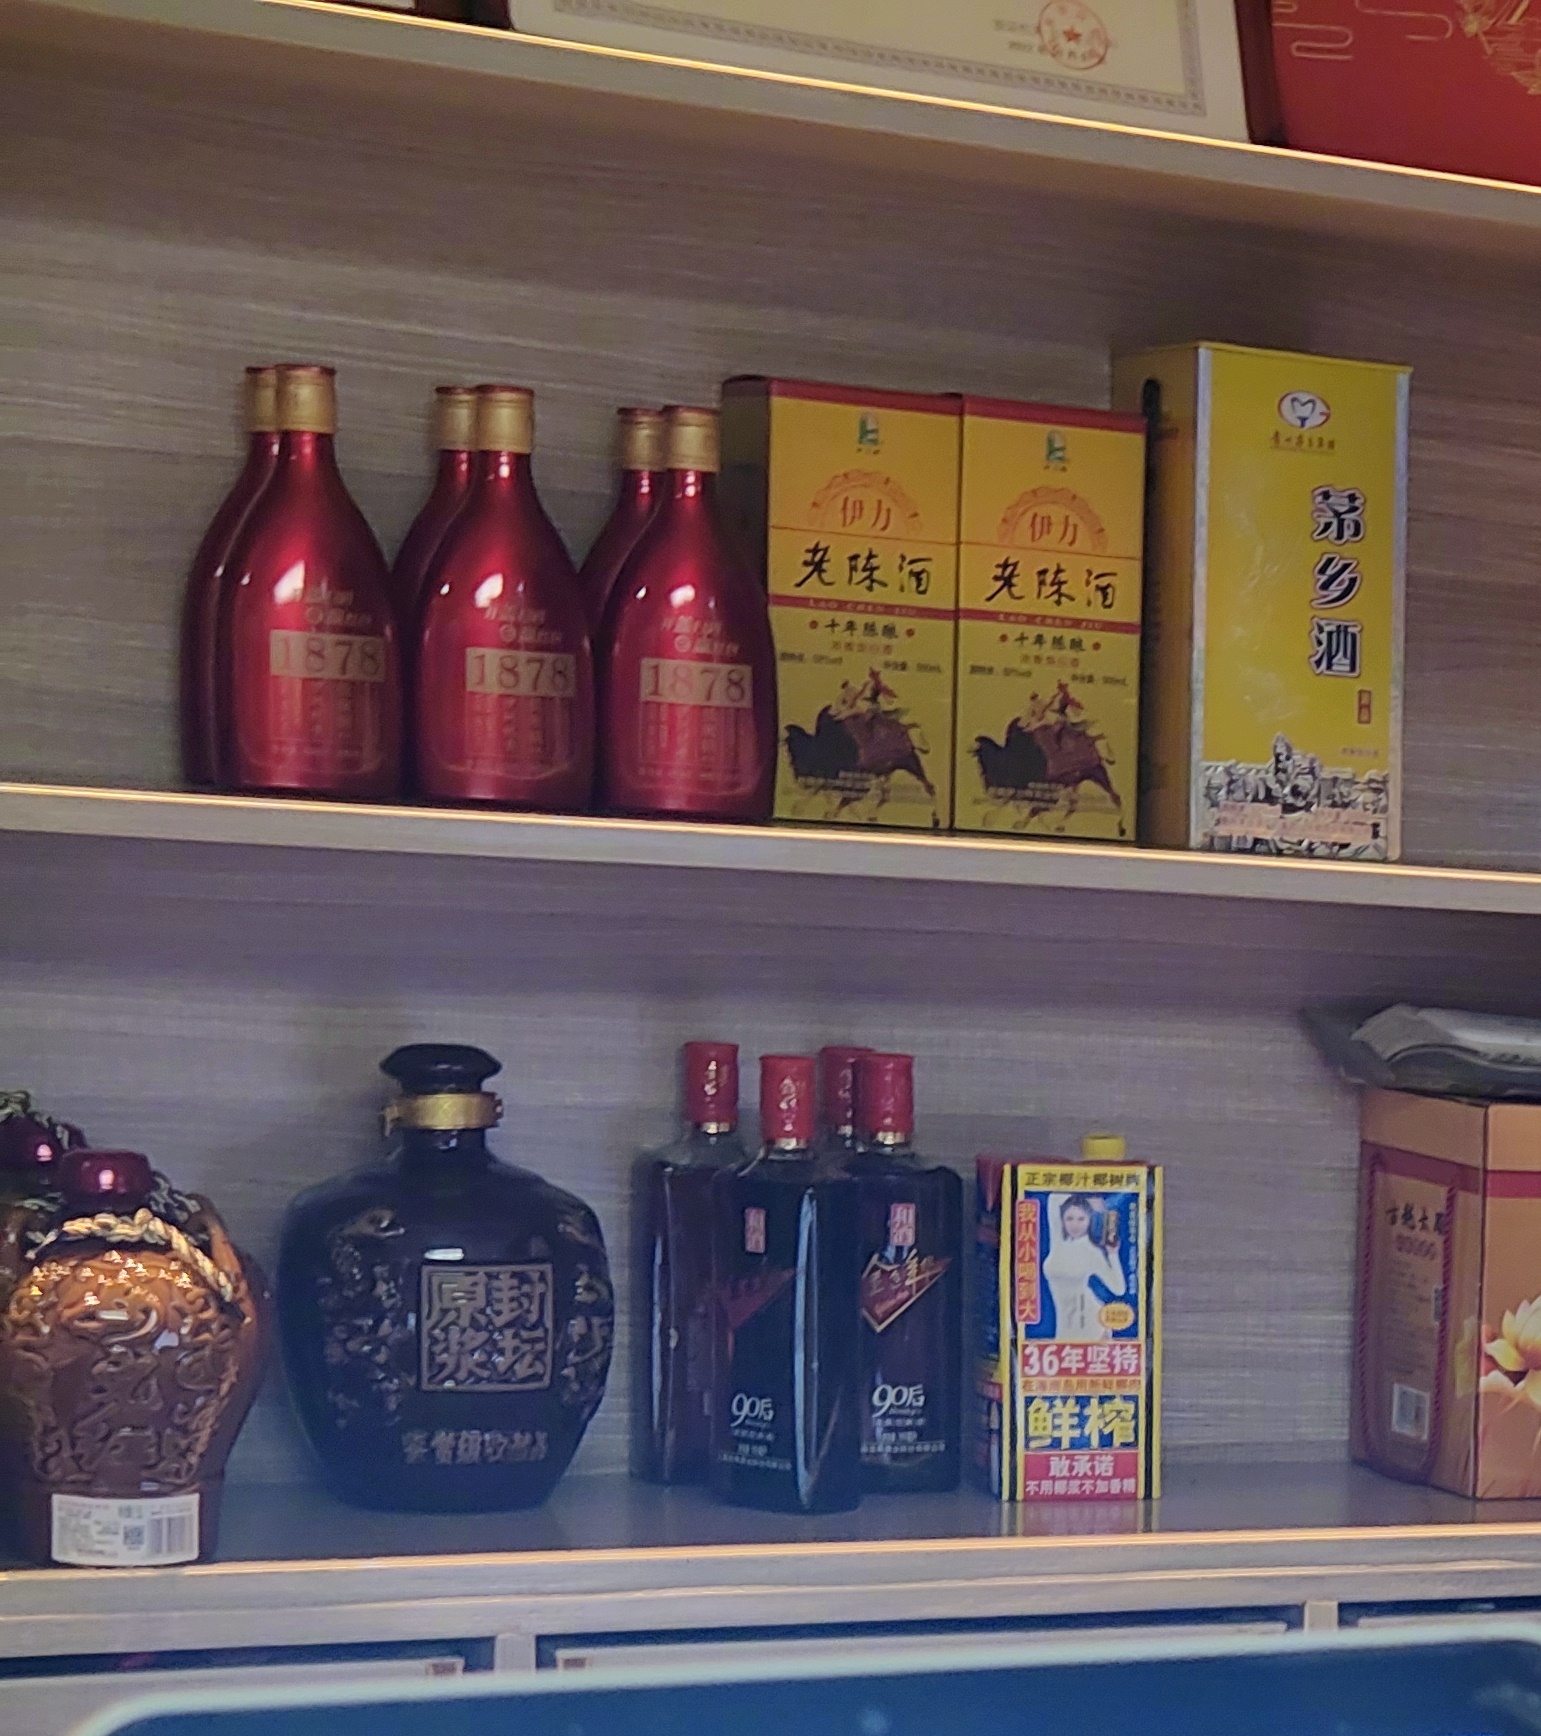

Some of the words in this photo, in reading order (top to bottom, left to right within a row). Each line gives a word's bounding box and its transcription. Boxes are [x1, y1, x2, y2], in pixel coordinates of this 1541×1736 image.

[839, 496, 891, 532] 伊力
[1029, 512, 1079, 547] 伊力
[794, 540, 934, 596] 老陈酒
[984, 556, 1118, 610] 老陈酒
[275, 636, 380, 677] 1878
[474, 653, 569, 692] 1878
[649, 663, 745, 703] 1878
[1017, 1201, 1038, 1322] 我从小喝到大
[1023, 1345, 1139, 1376] 36年坚持
[730, 1392, 775, 1427] 90后
[872, 1383, 926, 1418] 90后
[1027, 1397, 1136, 1449] 鲜榨
[1048, 1454, 1115, 1477] 敢承诺
